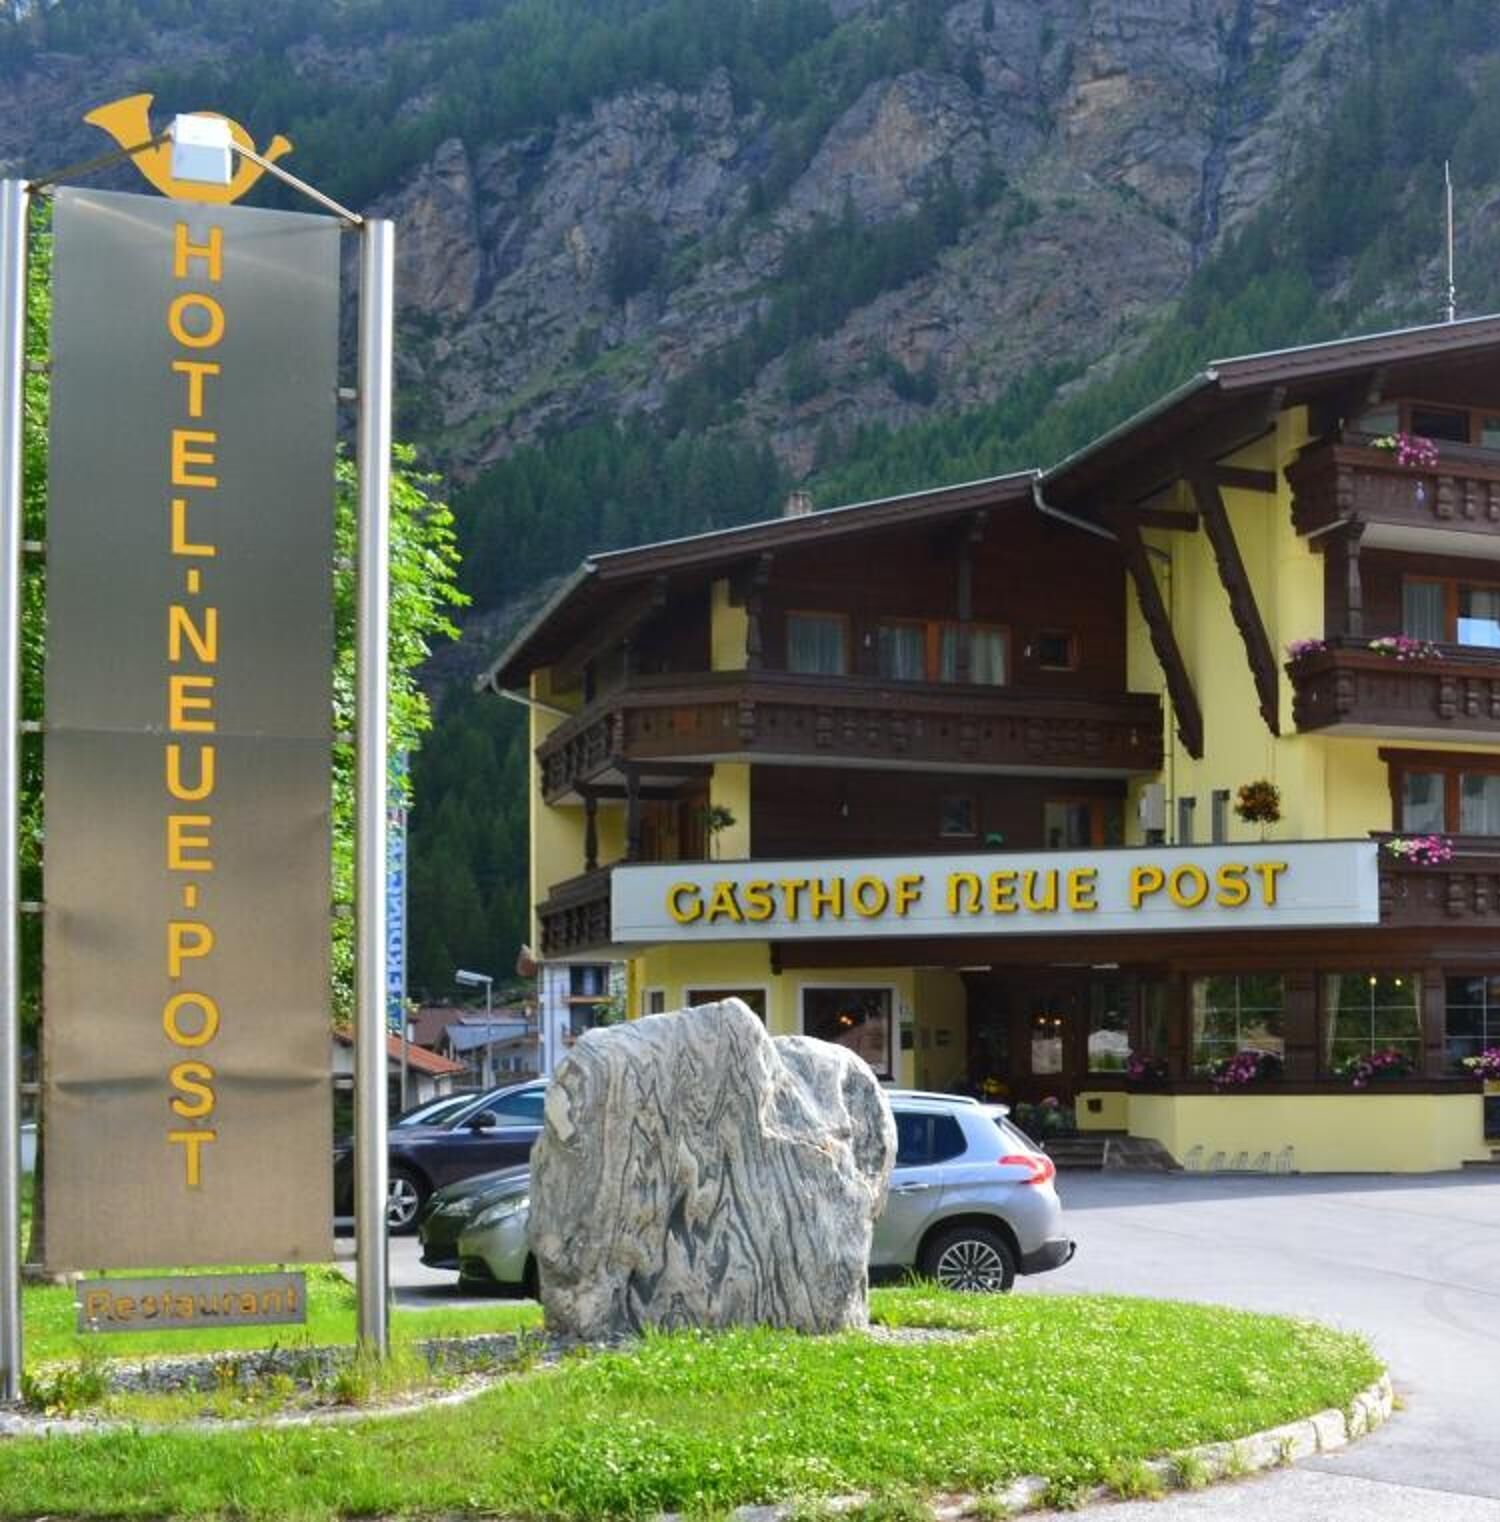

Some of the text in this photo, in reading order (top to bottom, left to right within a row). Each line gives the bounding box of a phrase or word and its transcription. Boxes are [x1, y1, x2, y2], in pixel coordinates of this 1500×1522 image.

[665, 861, 1289, 926] GASTHOF NEUE POST
[86, 1284, 297, 1321] Restaurant
